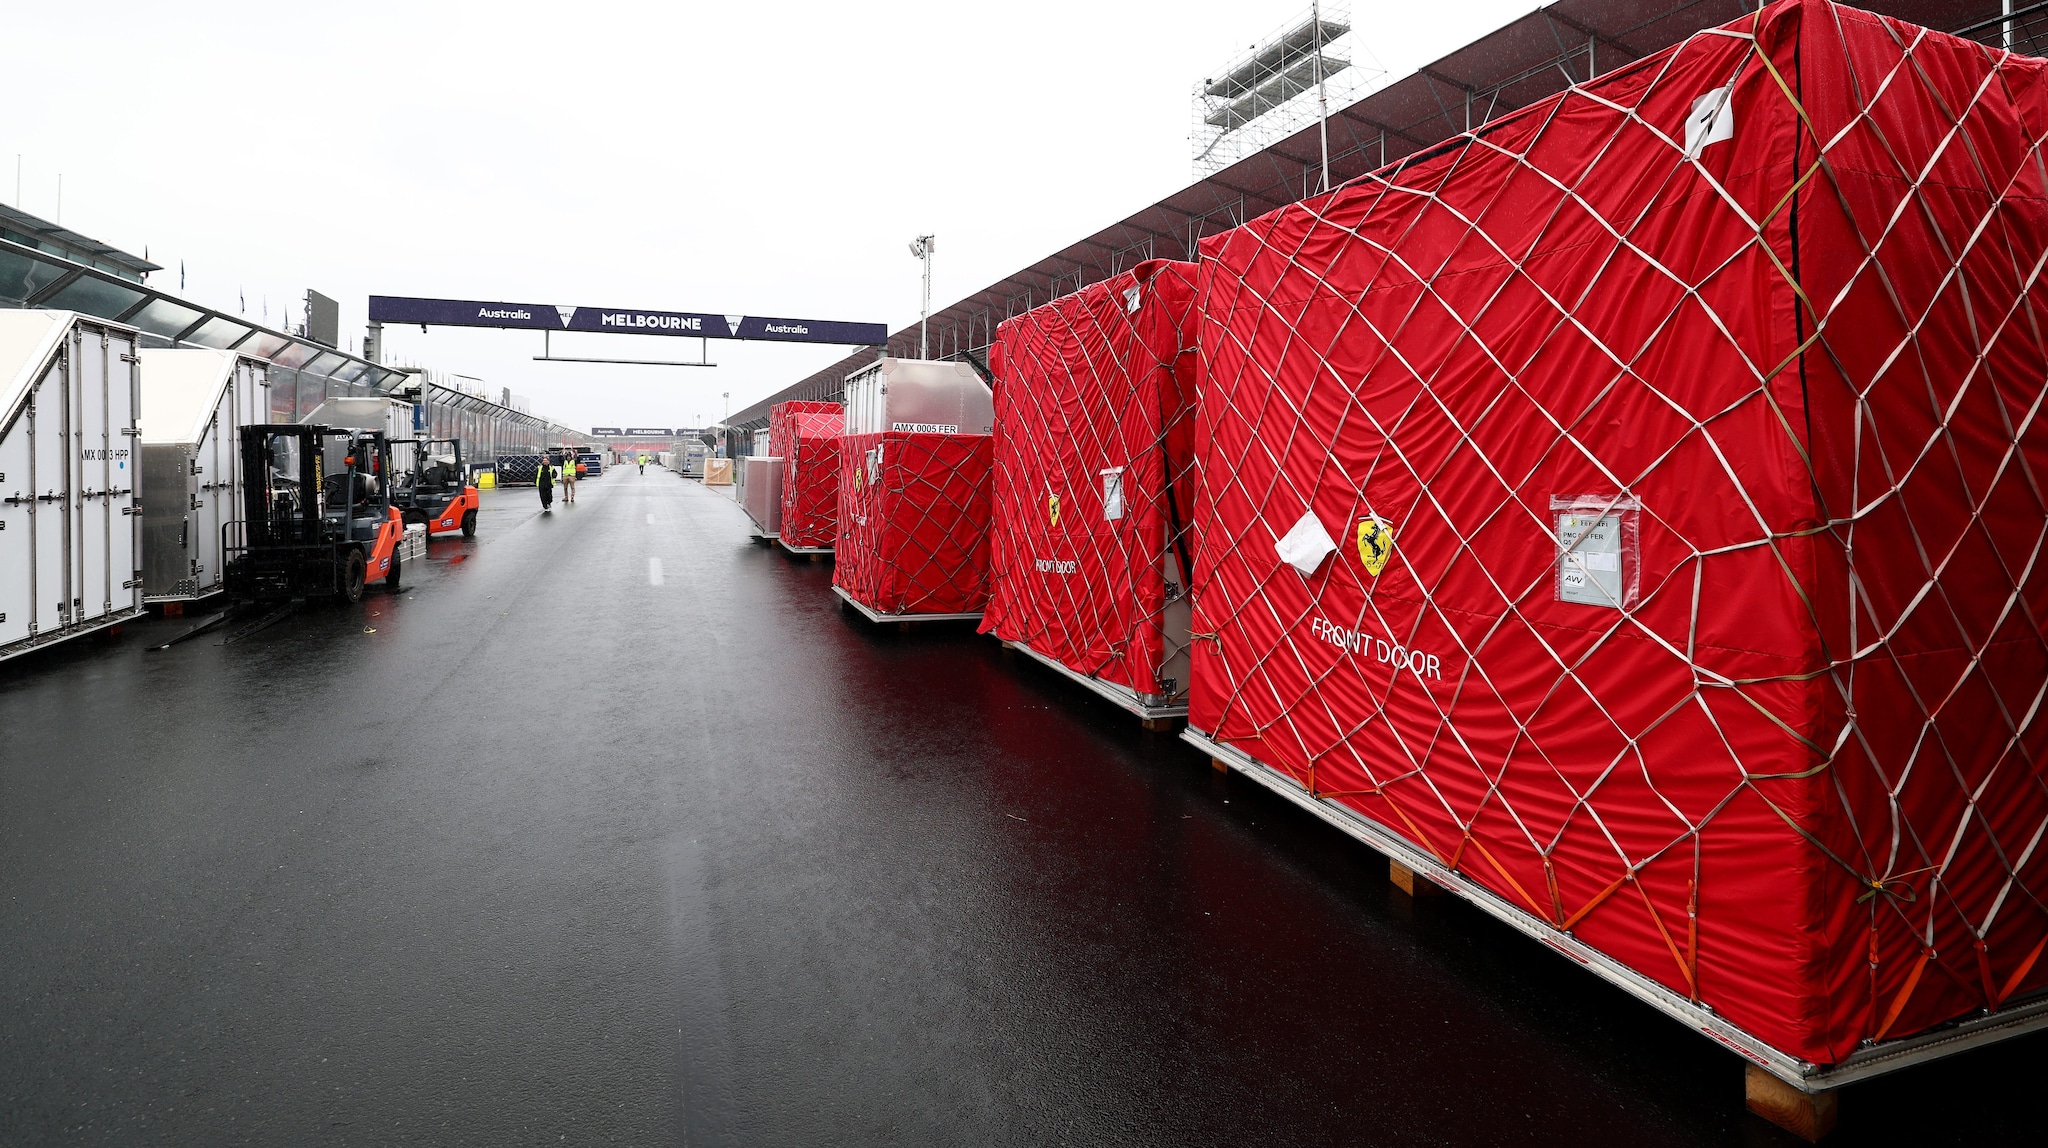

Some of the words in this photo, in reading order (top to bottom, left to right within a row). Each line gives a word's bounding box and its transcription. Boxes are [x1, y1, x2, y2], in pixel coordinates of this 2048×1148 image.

[478, 308, 531, 320] Australia
[601, 312, 702, 331] MELBOURNE
[764, 323, 809, 335] Australia
[894, 423, 915, 432] AMX
[916, 424, 937, 433] 0005
[938, 425, 957, 434] FER
[115, 449, 129, 461] HPP
[1565, 574, 1583, 584] AVV
[1311, 616, 1373, 657] FRONT
[1376, 639, 1441, 680] DOOR
